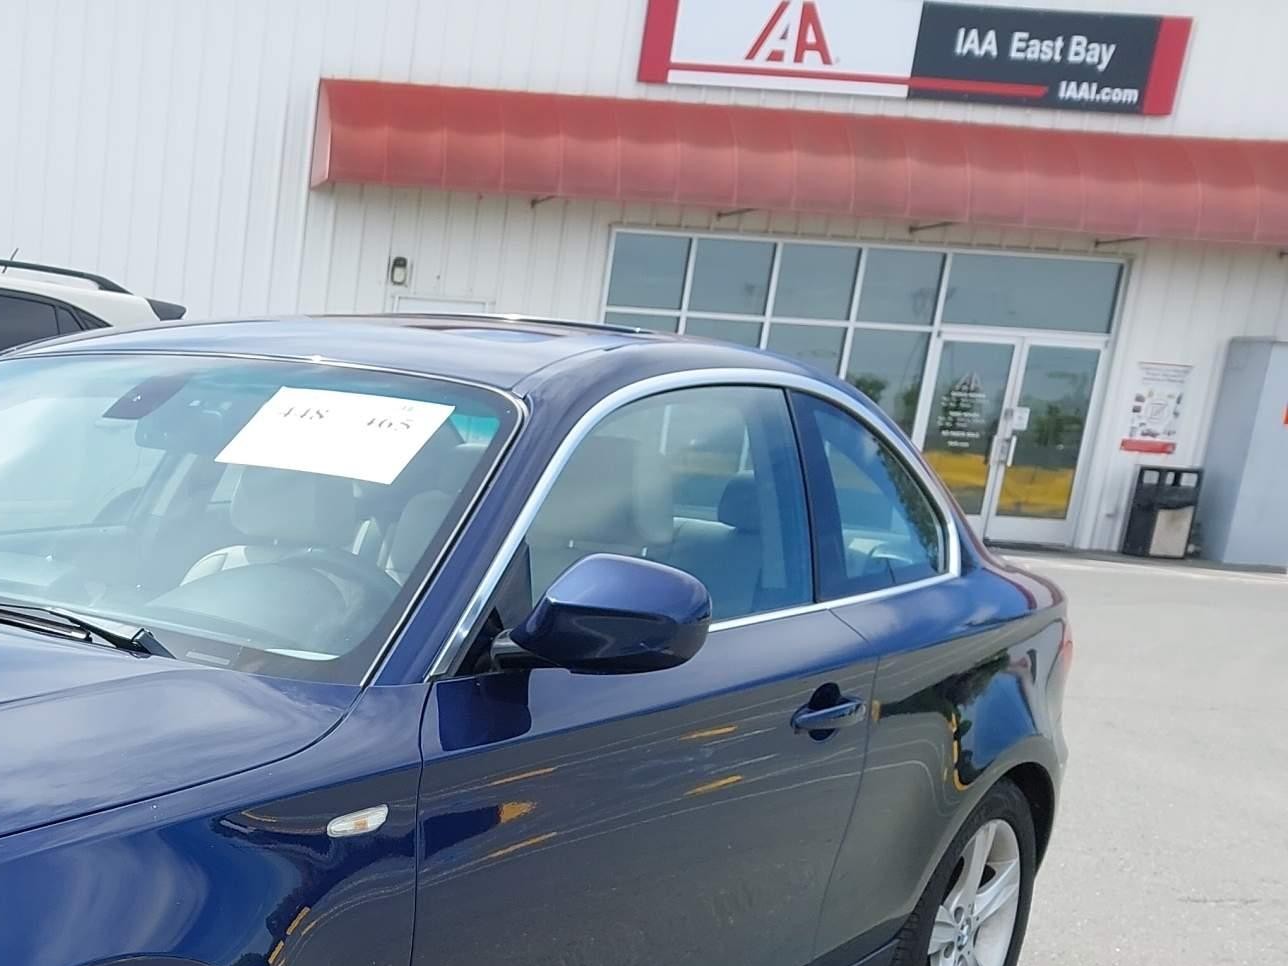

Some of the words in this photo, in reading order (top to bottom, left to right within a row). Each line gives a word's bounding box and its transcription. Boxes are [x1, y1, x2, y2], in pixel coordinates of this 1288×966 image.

[955, 27, 998, 57] IAA
[1010, 31, 1064, 62] East
[1067, 35, 1116, 72] Bay
[1058, 80, 1139, 104] IAAI.com
